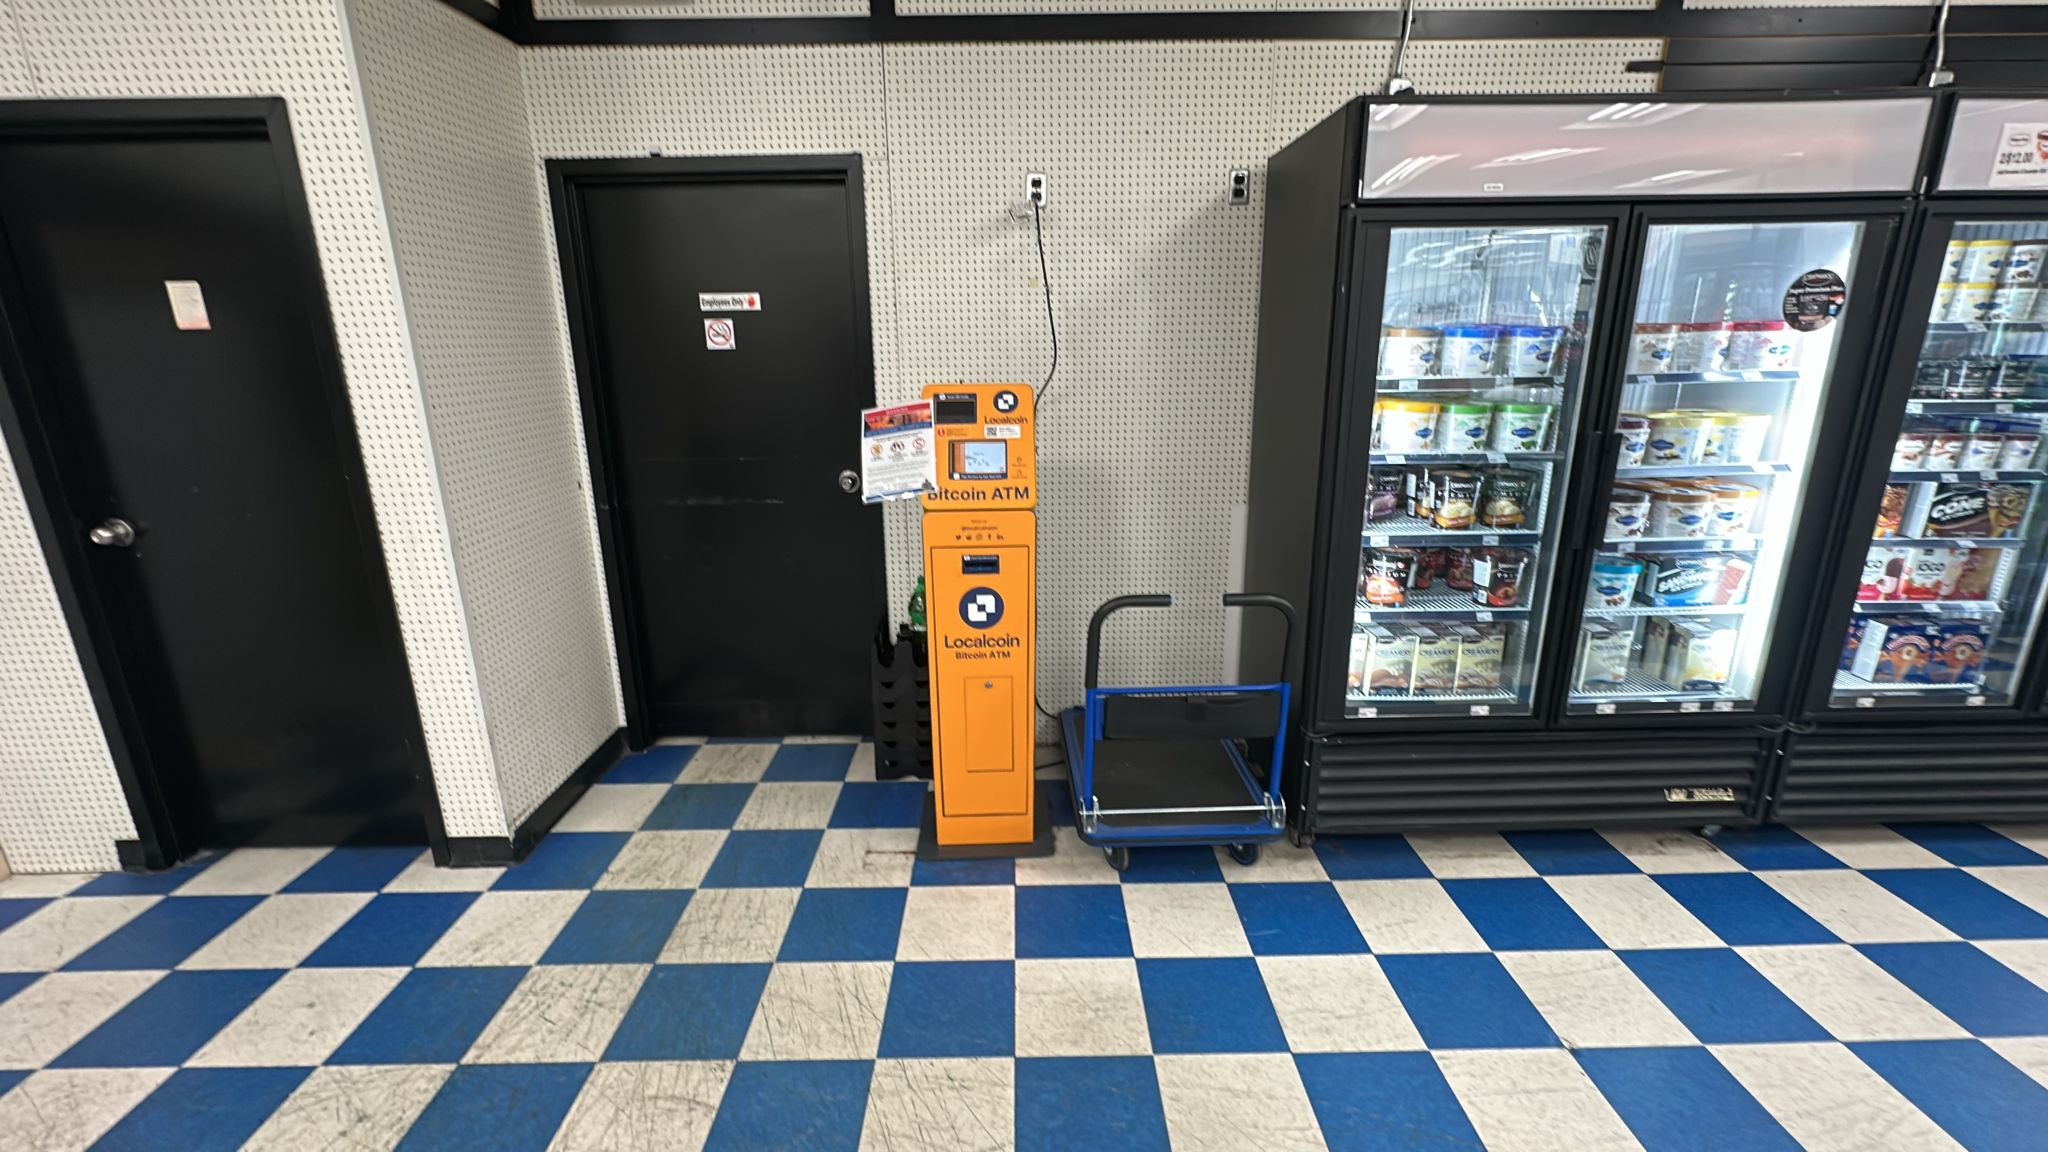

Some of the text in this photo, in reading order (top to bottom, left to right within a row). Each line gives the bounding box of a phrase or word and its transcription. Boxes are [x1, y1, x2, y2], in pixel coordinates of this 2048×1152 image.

[702, 296, 744, 308] Employees Only
[984, 415, 1028, 425] Localcoin
[927, 486, 1030, 501] Bitcoin ATM
[944, 634, 1020, 649] Localcoin
[956, 650, 1011, 660] Bitcoin ATM
